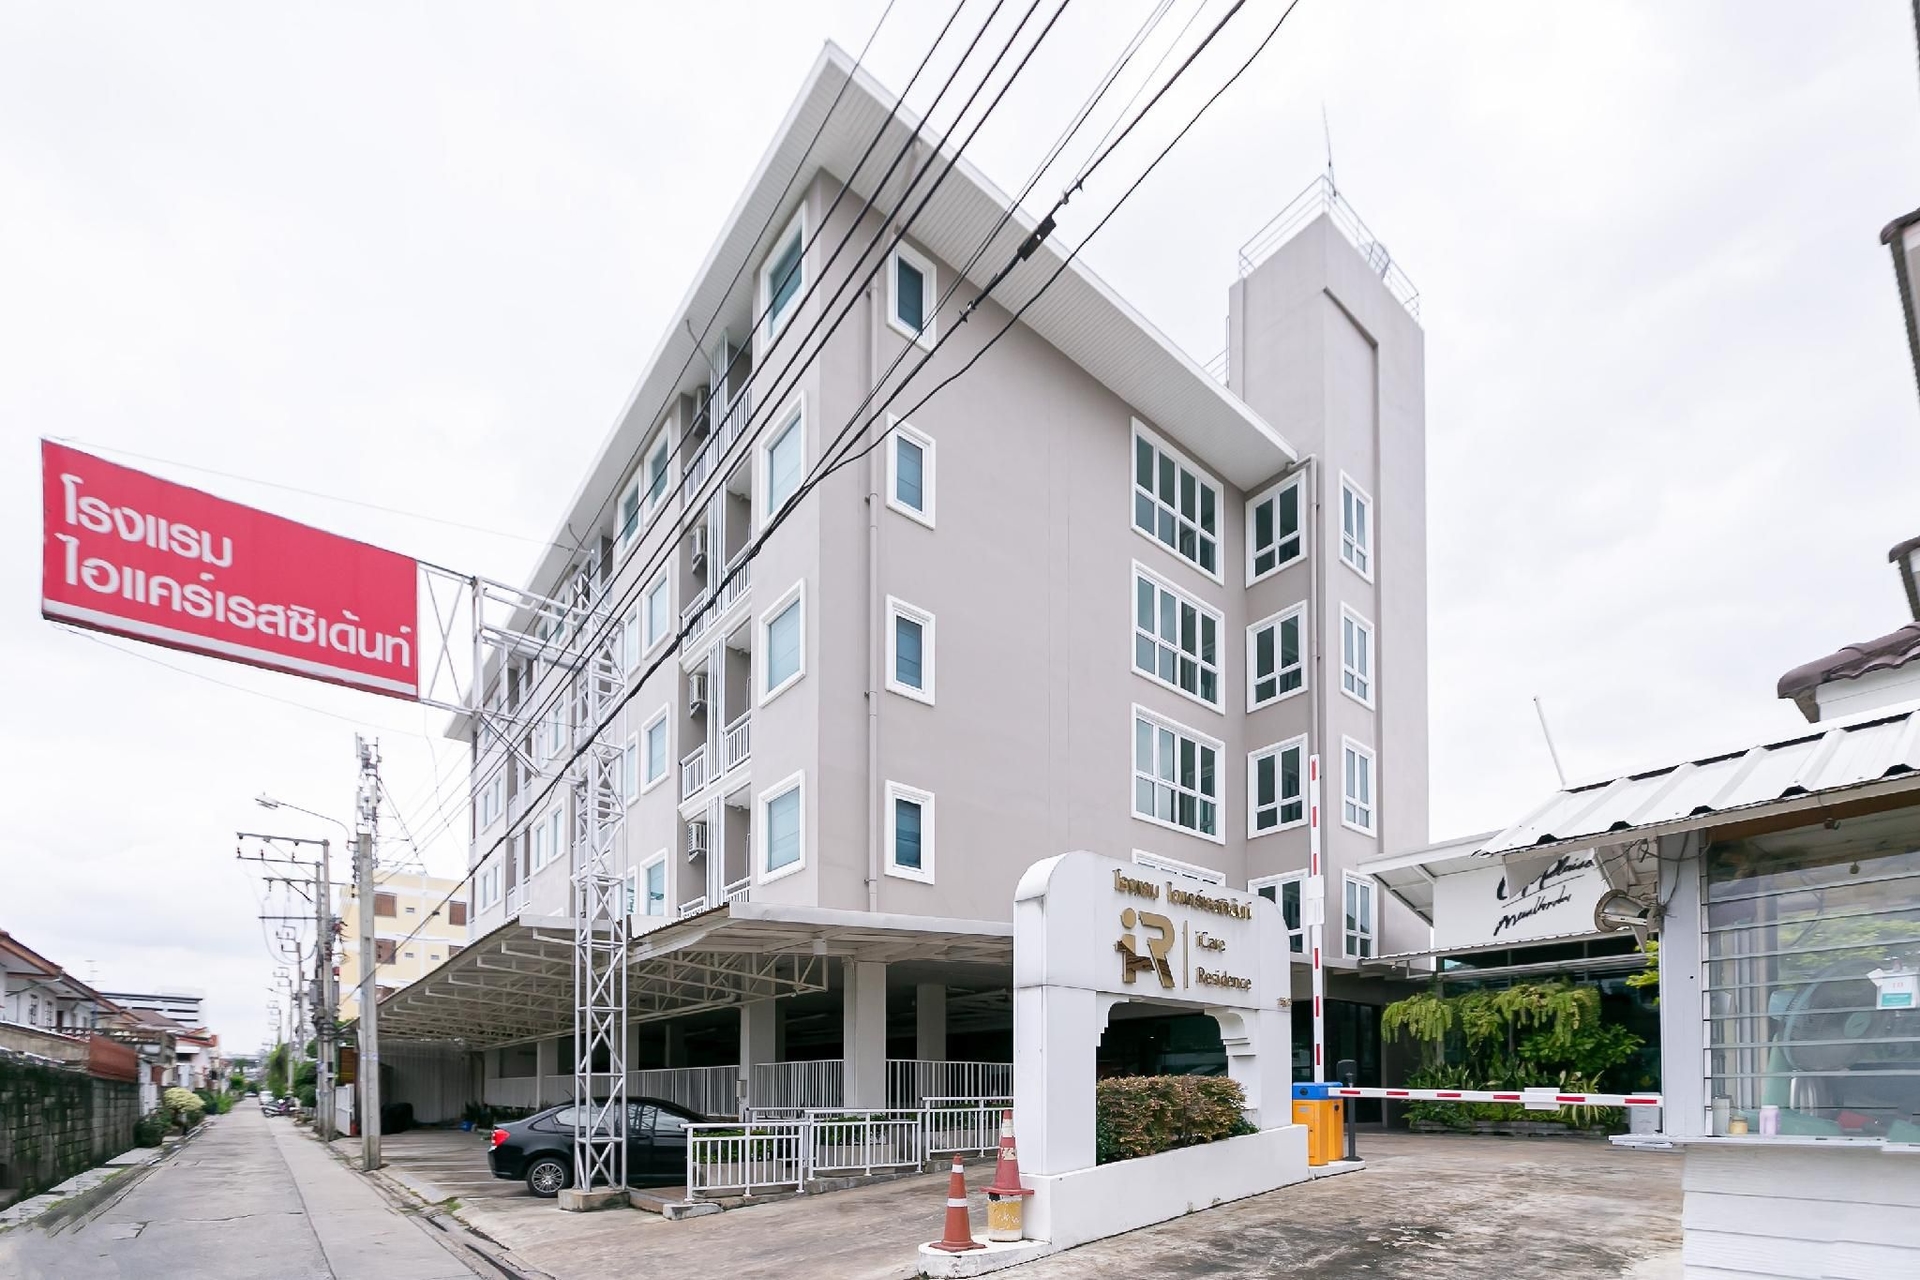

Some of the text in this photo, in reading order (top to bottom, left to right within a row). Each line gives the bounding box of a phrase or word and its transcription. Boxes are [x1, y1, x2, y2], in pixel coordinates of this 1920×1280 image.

[60, 474, 232, 567] โรงแรม
[1195, 930, 1226, 952] iCare
[1195, 966, 1252, 991] Residence
